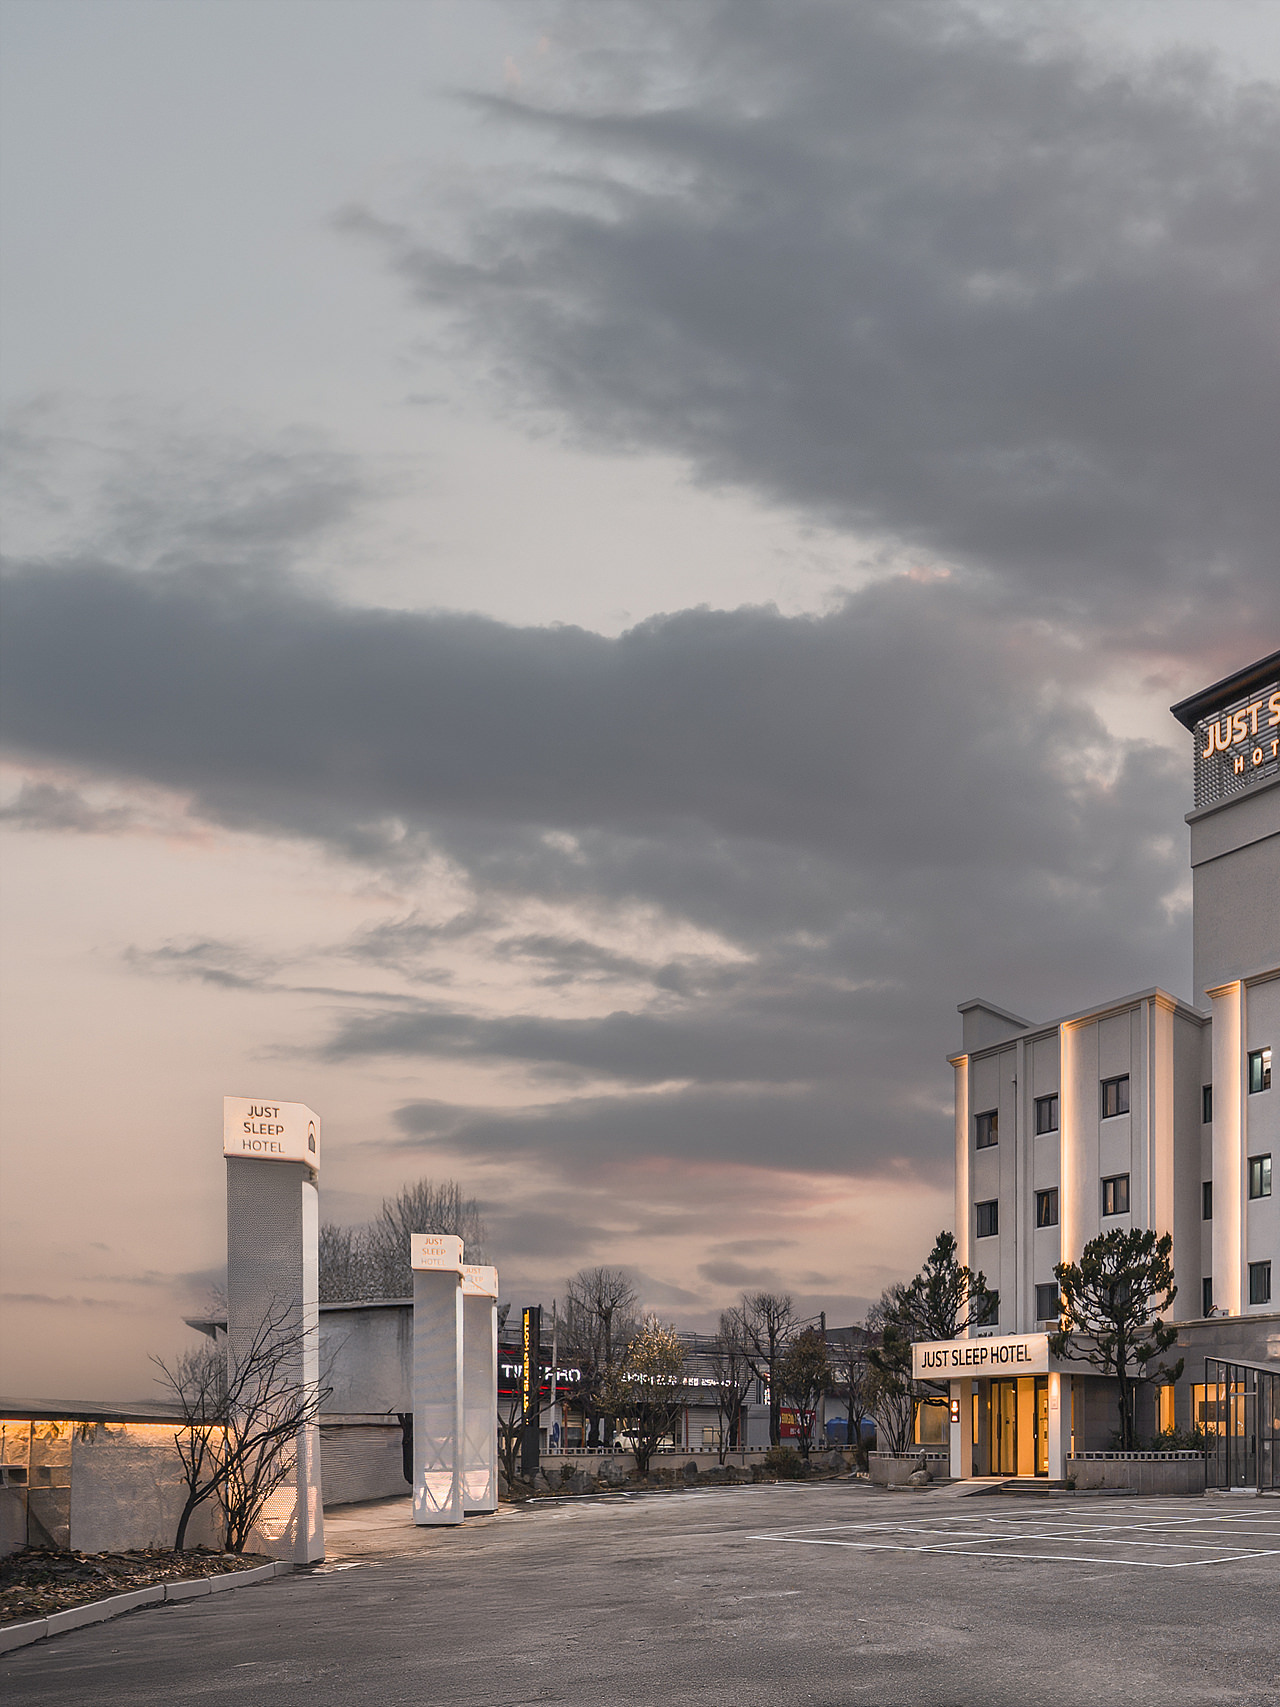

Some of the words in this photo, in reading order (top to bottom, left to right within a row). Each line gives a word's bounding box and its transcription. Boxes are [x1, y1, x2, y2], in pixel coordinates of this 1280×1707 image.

[1202, 700, 1263, 758] JUST
[247, 1105, 280, 1118] JUST
[243, 1122, 284, 1135] SLEEP
[242, 1139, 285, 1153] HOTEL
[424, 1238, 443, 1246] JUST
[422, 1248, 447, 1256] SLEEP
[421, 1258, 446, 1266] HOTEL
[921, 1350, 949, 1368] JUST
[951, 1347, 988, 1367] SLEEP
[991, 1344, 1031, 1364] HOTEL
